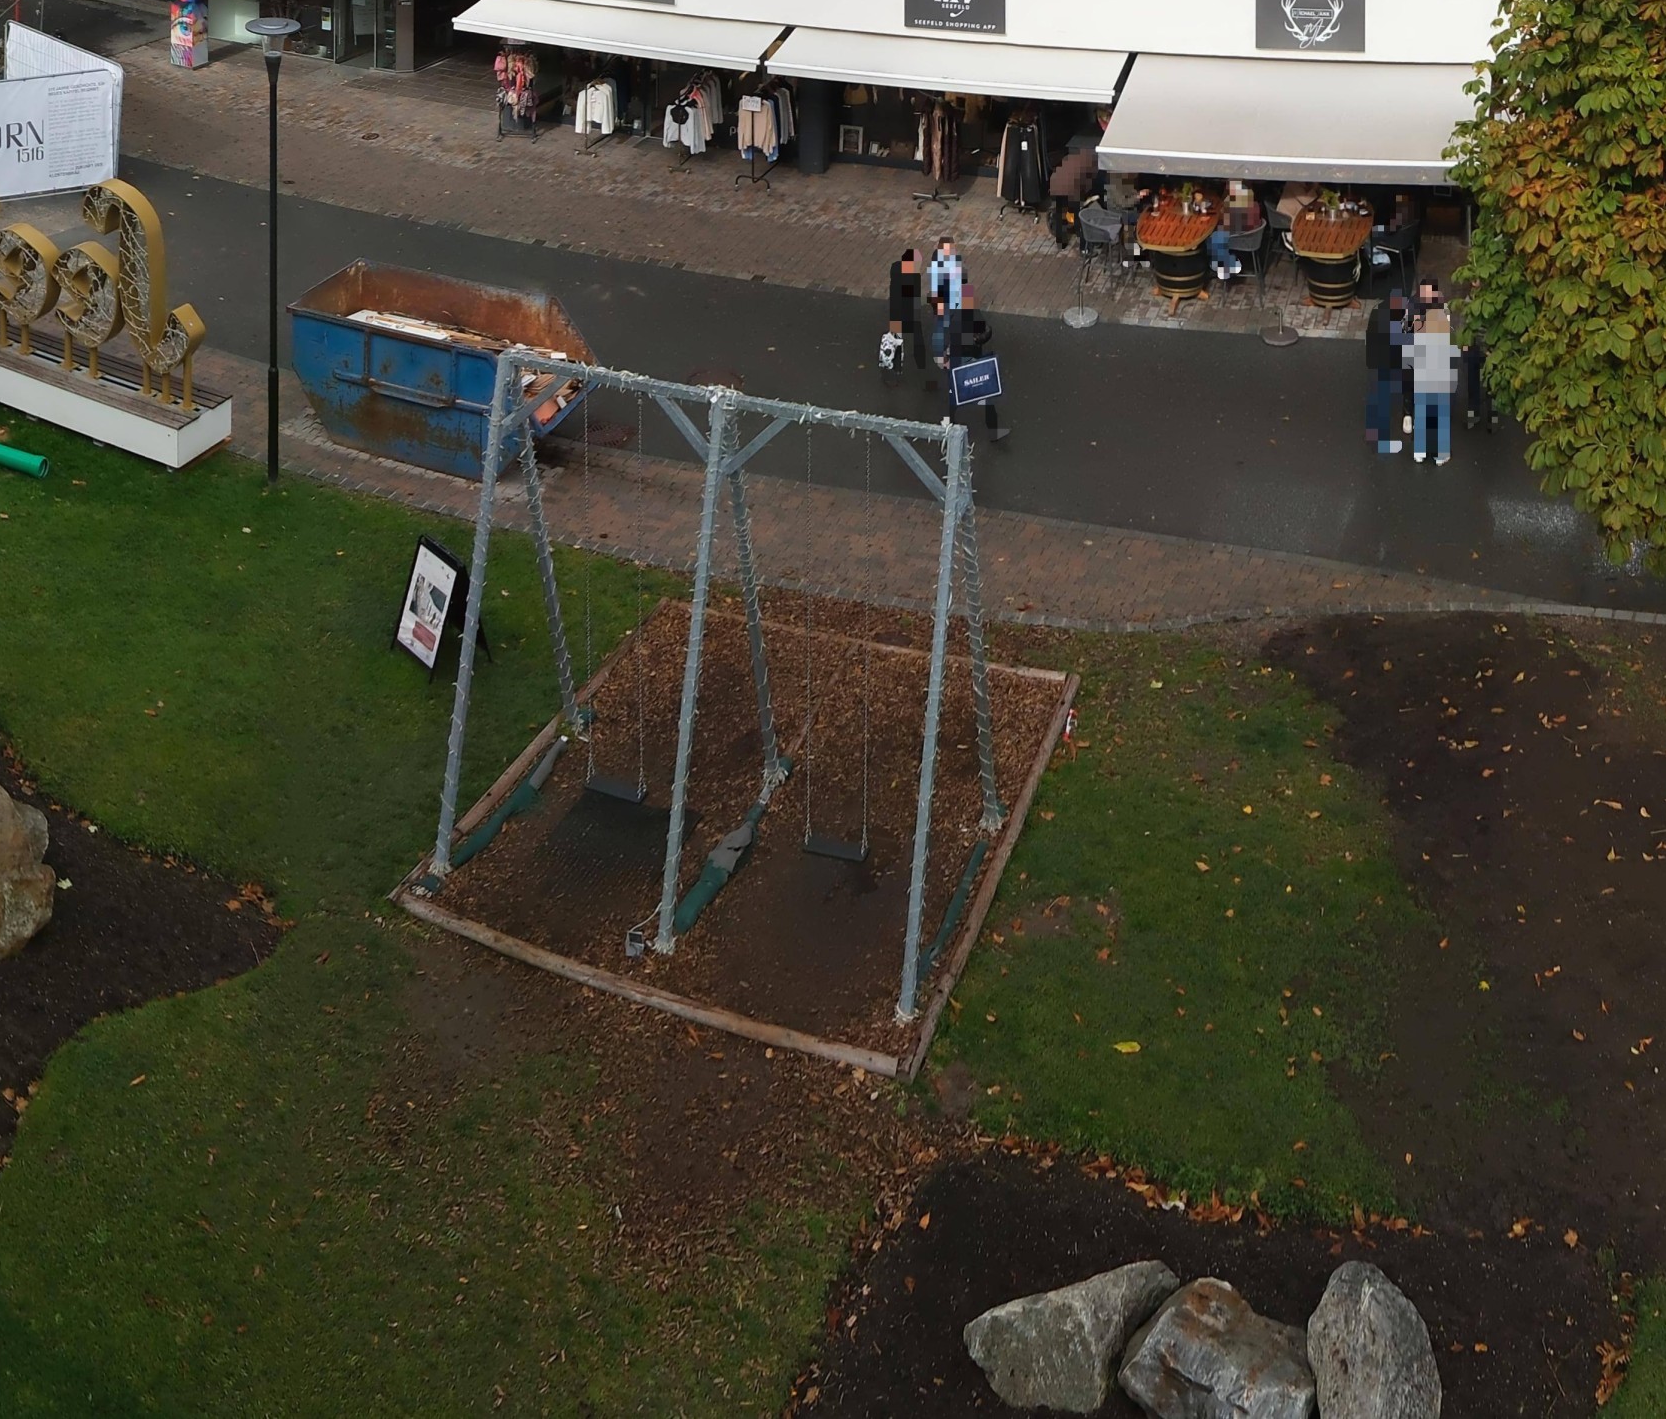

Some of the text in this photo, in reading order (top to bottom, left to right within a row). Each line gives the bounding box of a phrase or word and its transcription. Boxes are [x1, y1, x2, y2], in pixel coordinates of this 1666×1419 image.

[914, 19, 943, 27] SEEFELD
[946, 21, 981, 29] SHOPPING
[17, 146, 44, 163] 1516
[964, 374, 990, 386] SAILER
